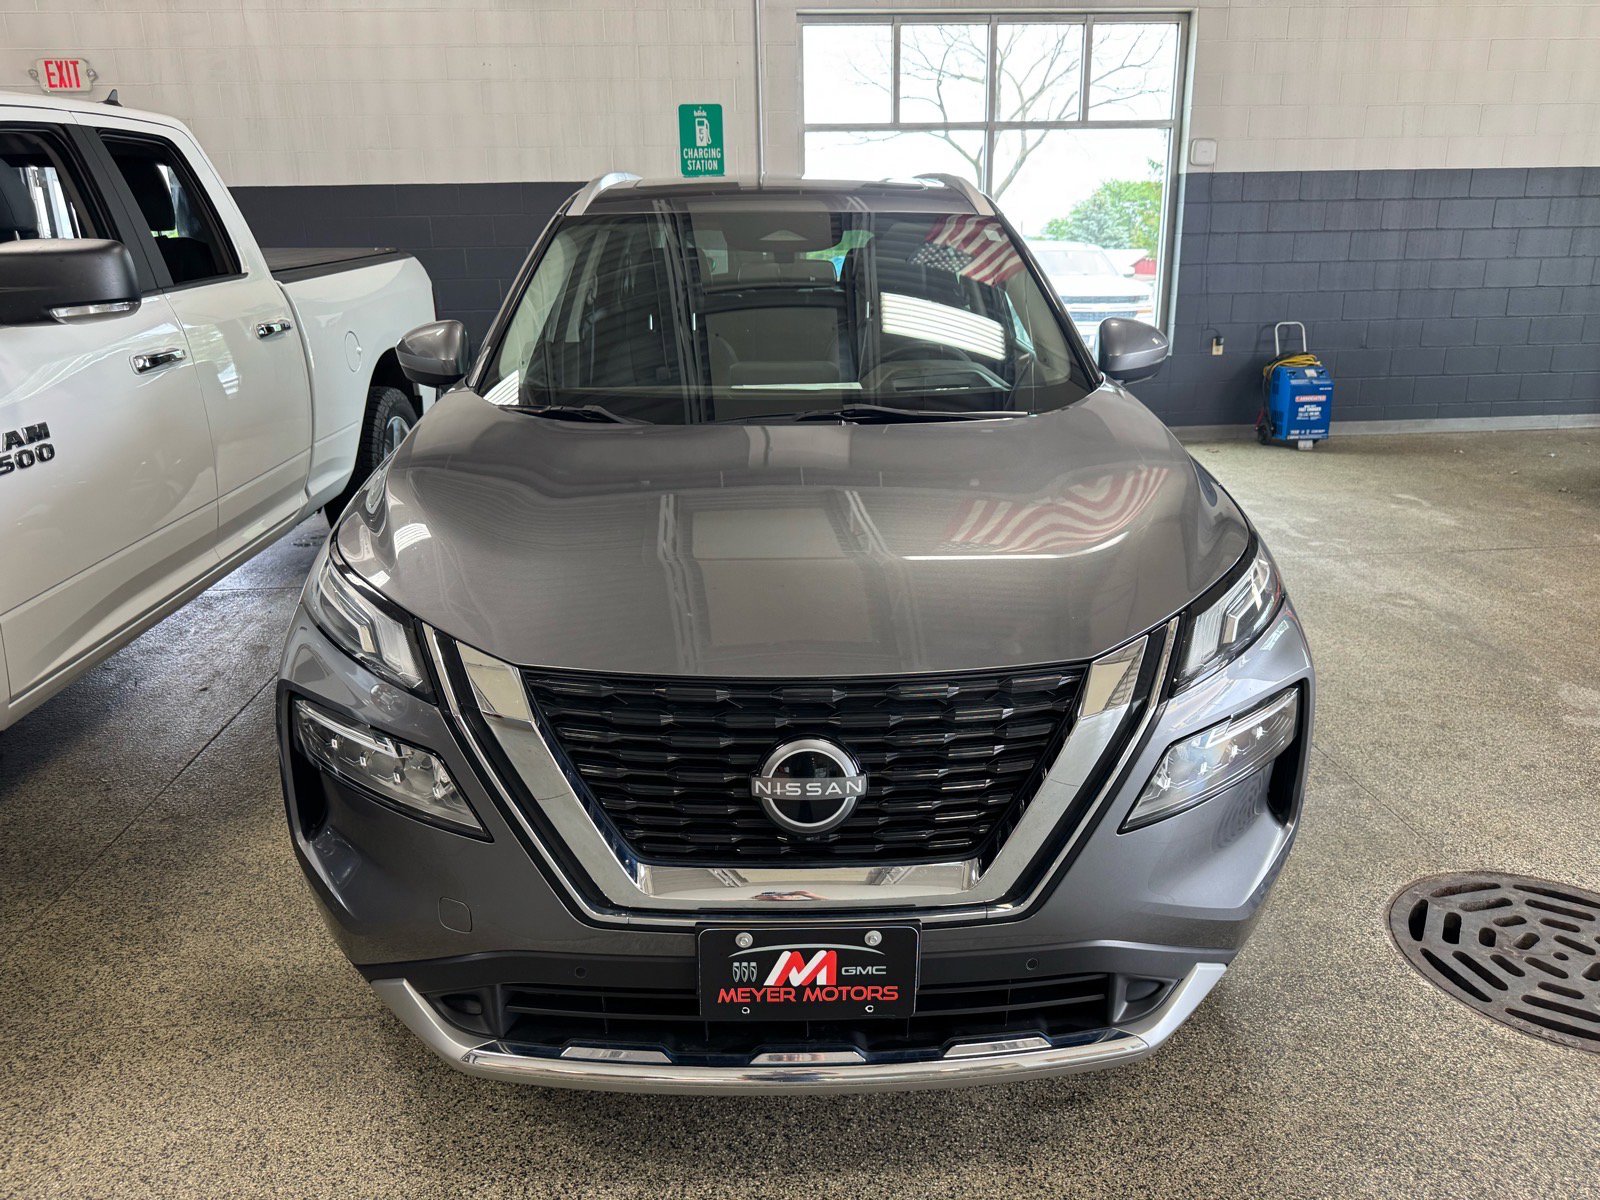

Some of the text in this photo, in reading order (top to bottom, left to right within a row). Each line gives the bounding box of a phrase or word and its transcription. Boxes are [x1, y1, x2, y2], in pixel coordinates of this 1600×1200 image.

[44, 60, 81, 88] EXIT
[683, 148, 721, 159] CHARGING
[687, 159, 718, 171] STATION
[0, 421, 51, 453] AM
[755, 779, 862, 796] NISSAN
[841, 965, 887, 976] GMC
[717, 985, 899, 1004] MEYER MOTORS
